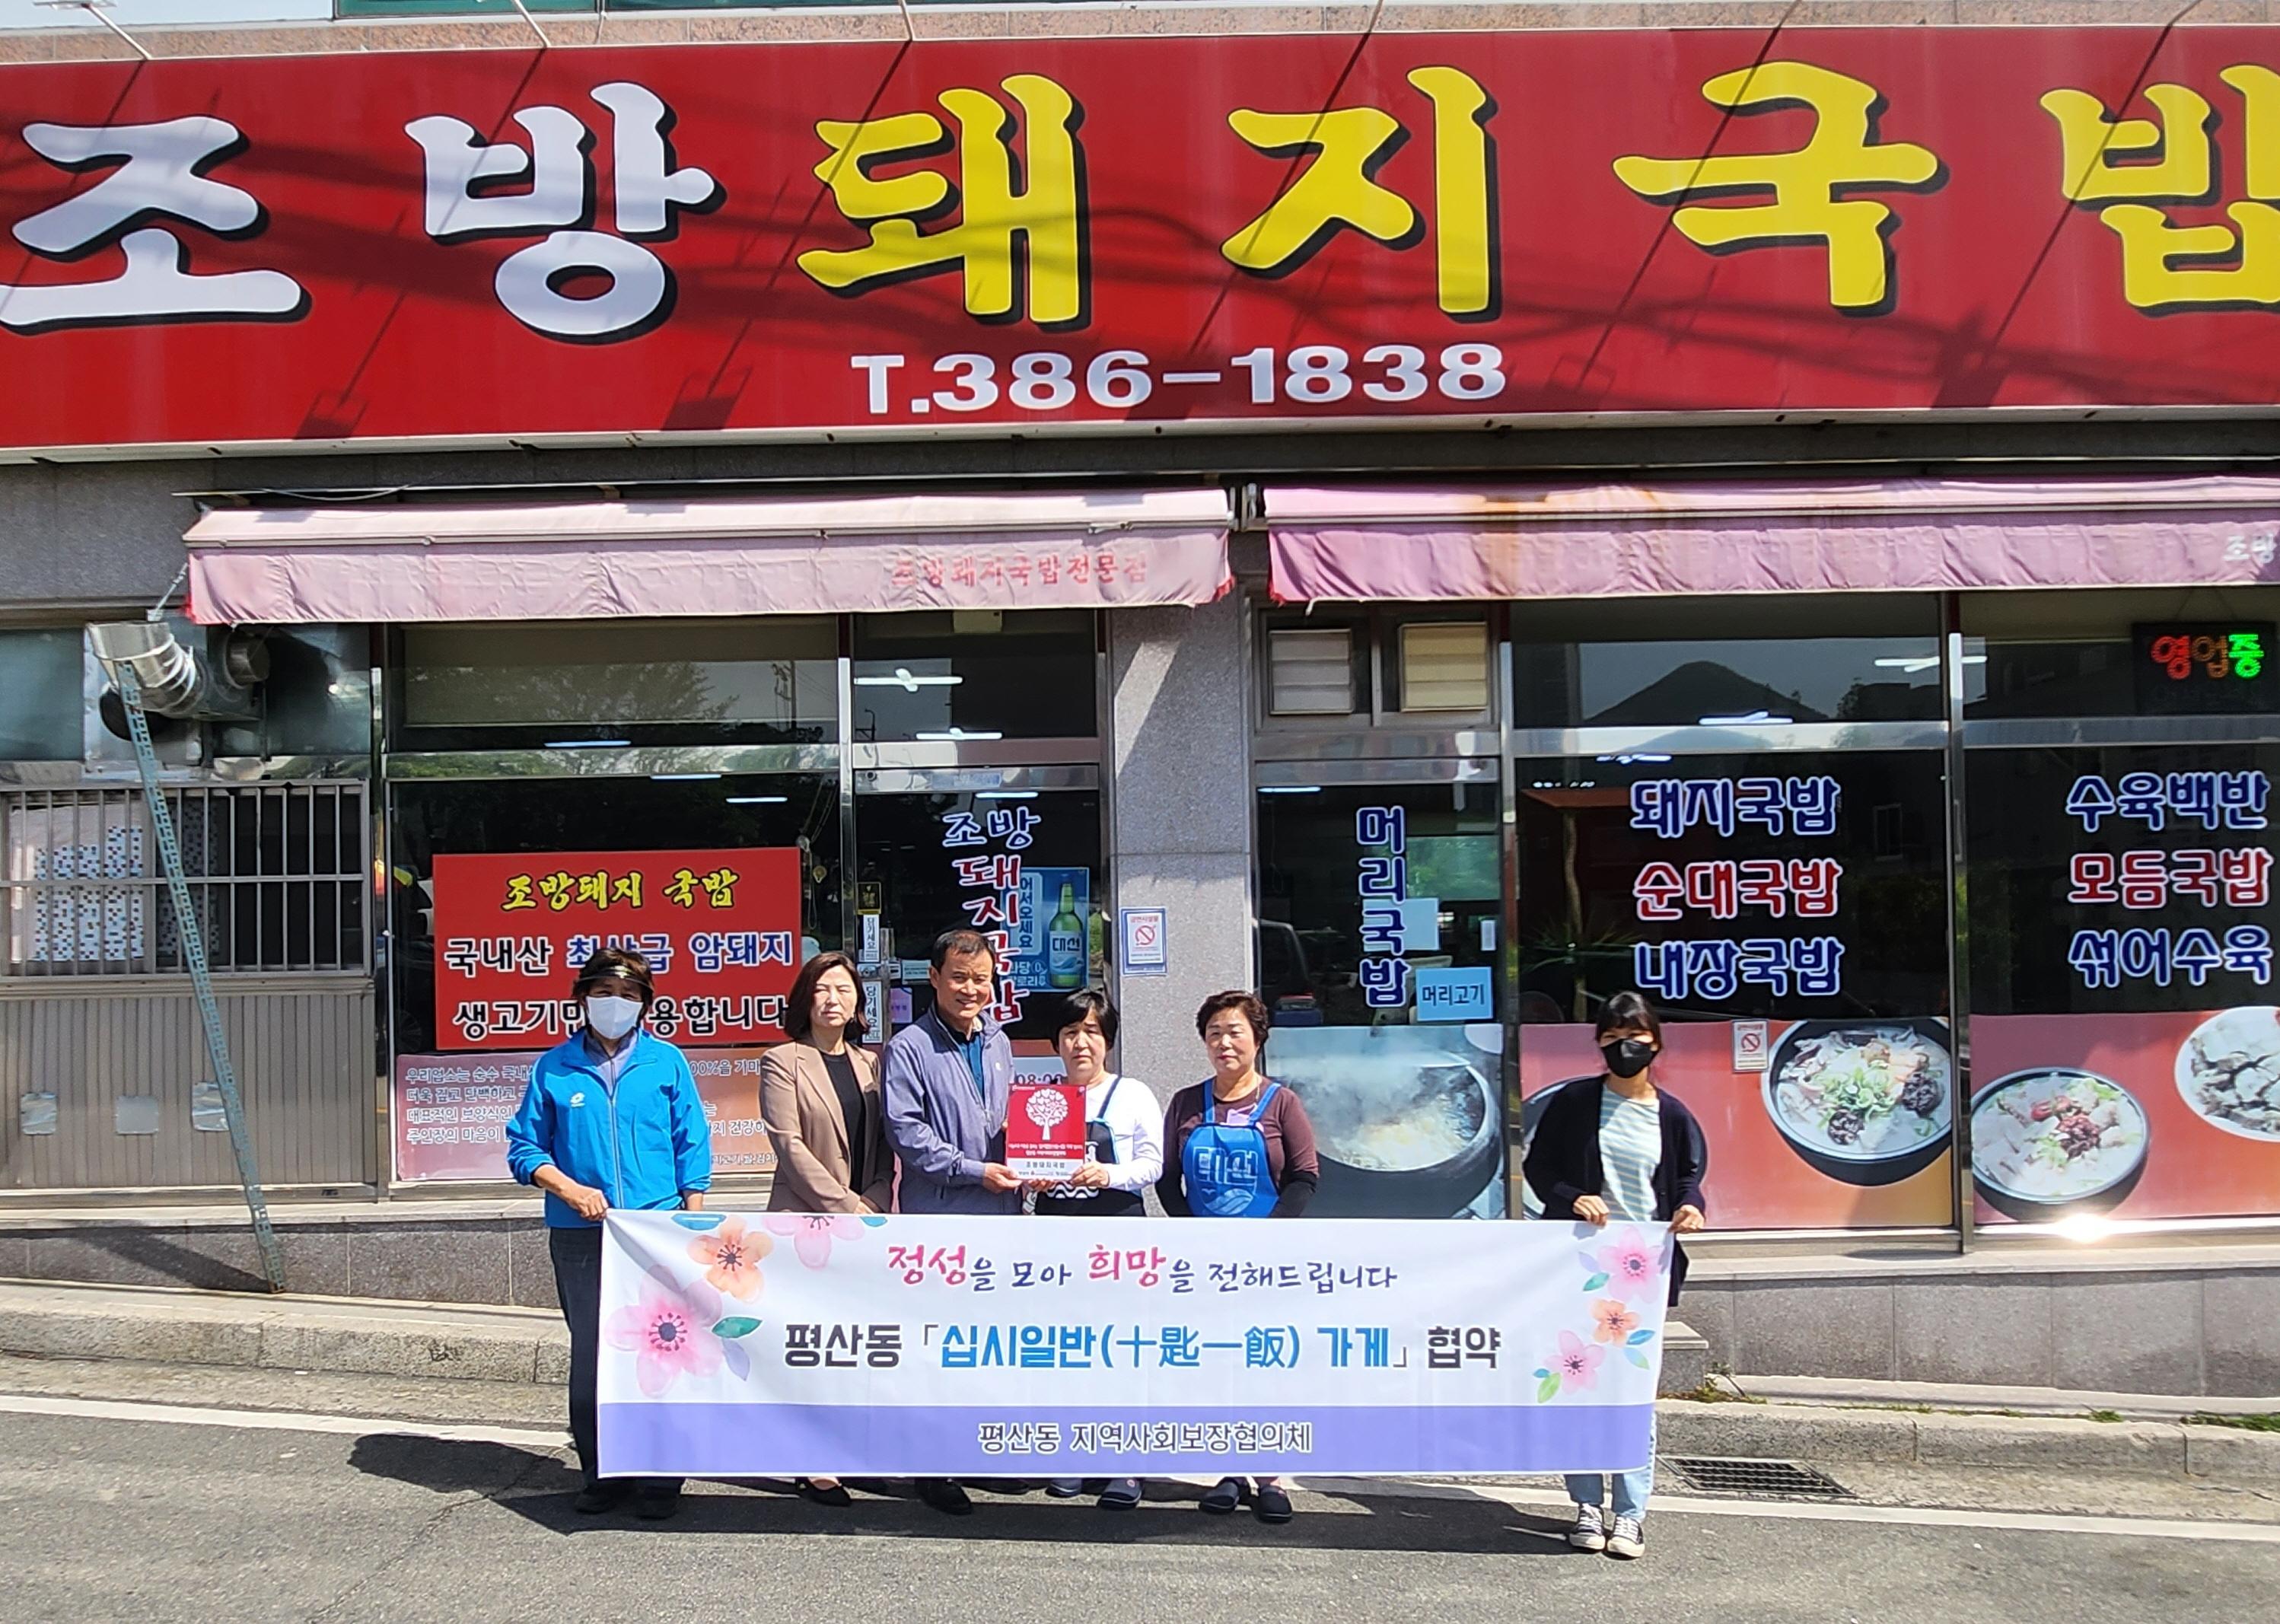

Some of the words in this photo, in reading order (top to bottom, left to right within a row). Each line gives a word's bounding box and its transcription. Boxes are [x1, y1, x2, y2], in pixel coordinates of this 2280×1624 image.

[2151, 633, 2265, 680] 영업중
[1629, 775, 1842, 839] 돼지국밥
[2065, 770, 2271, 833] 수육백반
[942, 807, 1042, 850] 조방
[1632, 858, 1843, 921] 순대국밥
[2067, 846, 2275, 909] 모듬국밥
[1018, 877, 1033, 948] 어서오세요
[1356, 804, 1412, 1008] 머리국밥
[444, 936, 553, 979] 국내산
[689, 931, 793, 973] 암돼지
[1634, 936, 1845, 1000] 내장국밥
[2068, 924, 2274, 989] 섞어수육
[645, 995, 791, 1036] 용합니다
[1422, 984, 1485, 1006] 머리고기
[406, 1087, 432, 1104] 더욱
[473, 1066, 499, 1082] 순수
[406, 1107, 458, 1124] 대표적인
[460, 1104, 512, 1123] 보양식인
[462, 1126, 500, 1143] 마음이
[886, 1243, 998, 1292] 정성을
[1009, 1260, 1072, 1288] 모아
[1087, 1242, 1196, 1294] 희망을
[1208, 1260, 1398, 1294] 전해드립니다
[783, 1323, 903, 1369] 평산동
[1426, 1325, 1502, 1370] 협약
[977, 1422, 1060, 1454] 평산동
[1070, 1421, 1314, 1454] 지역사회보장협의체
